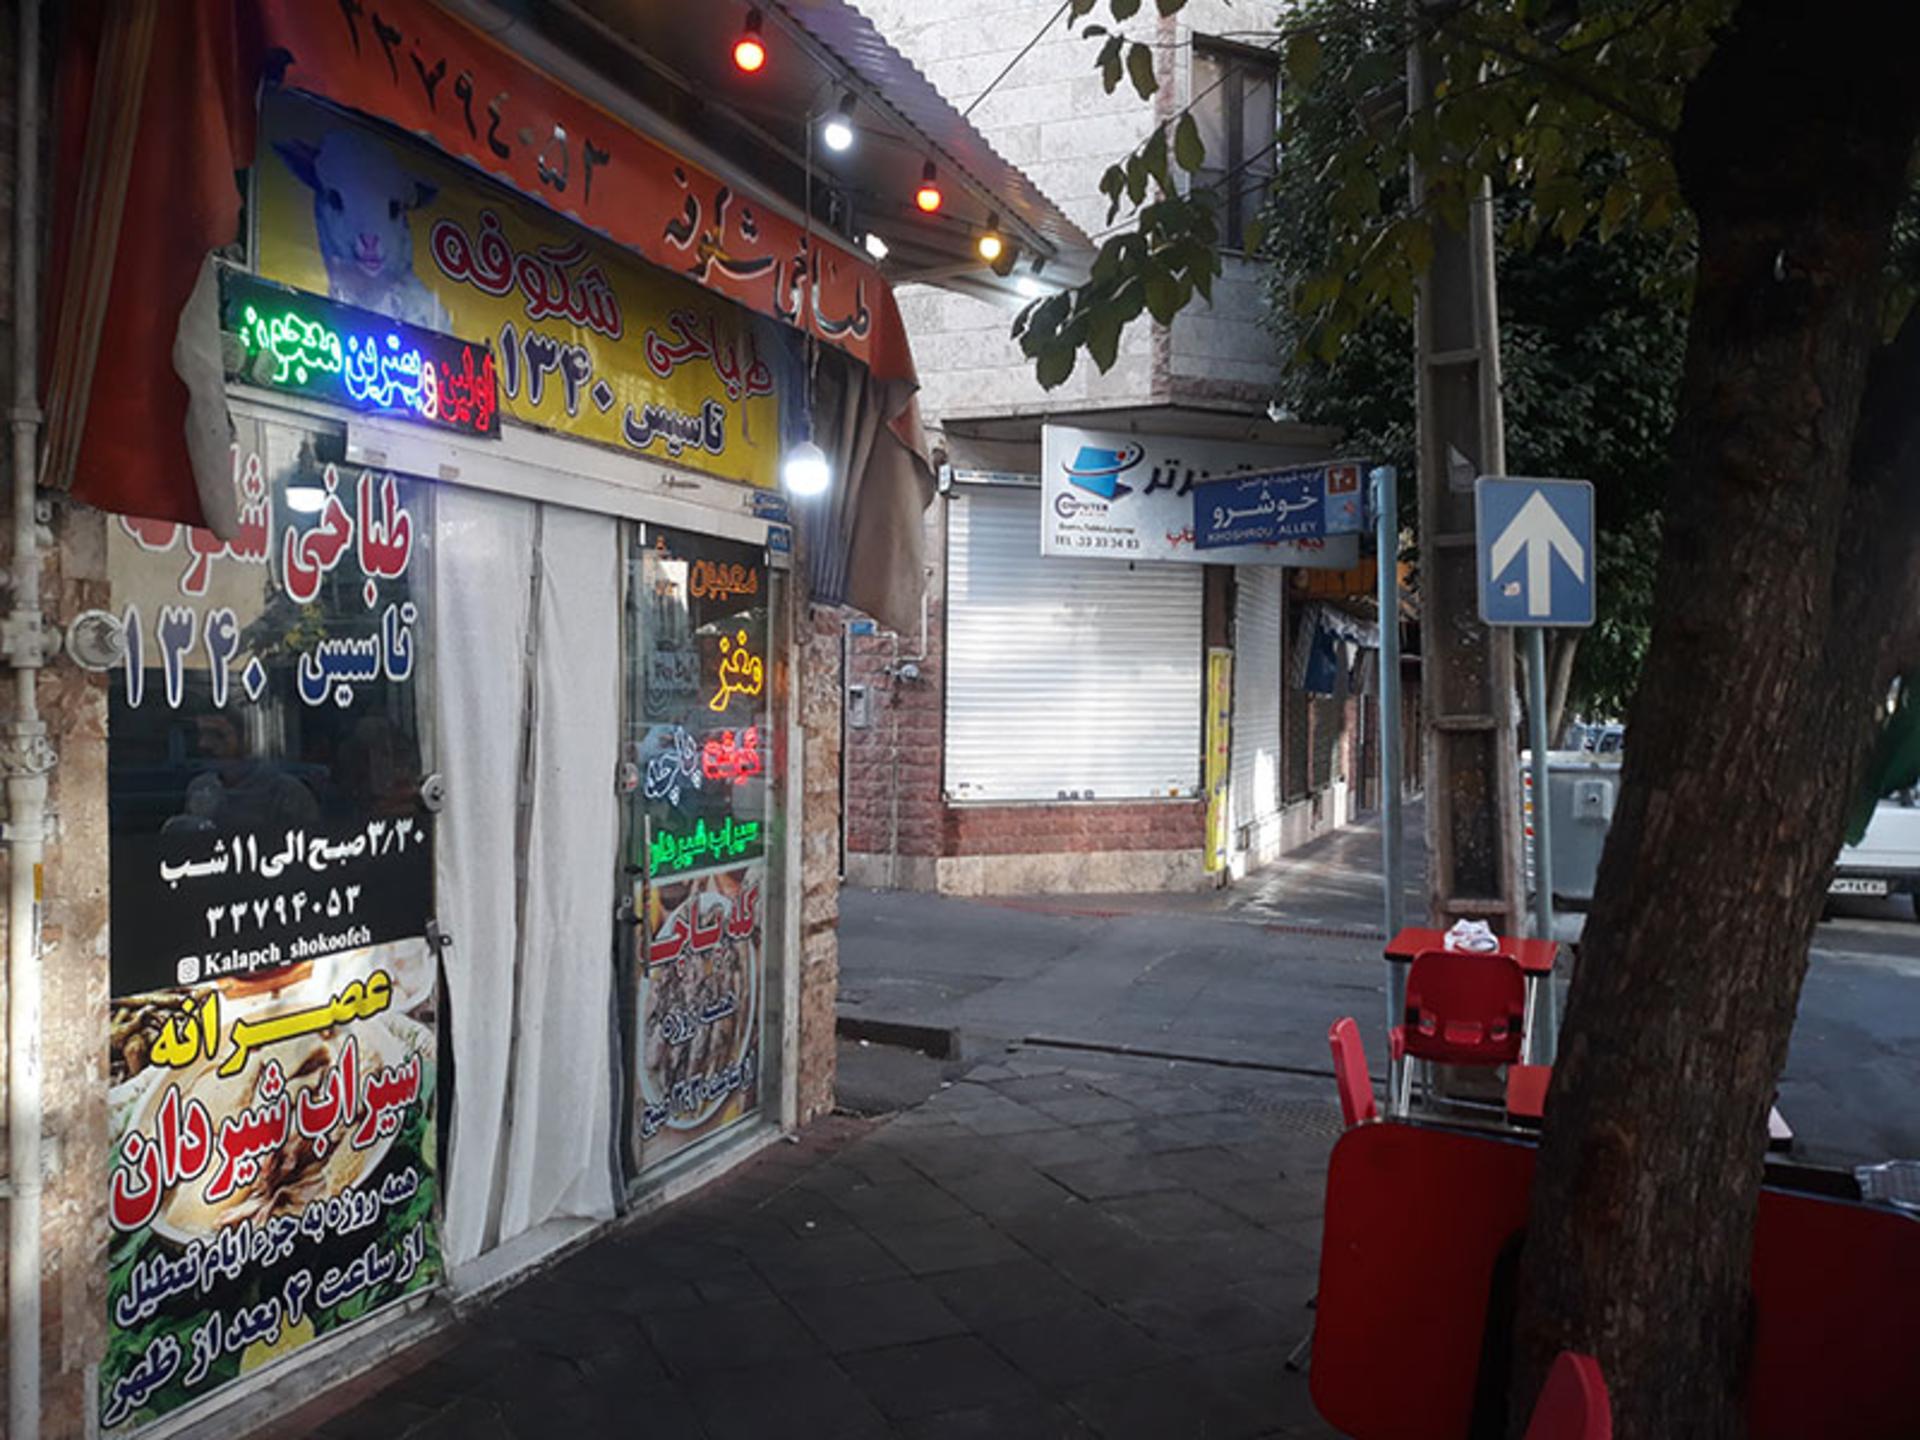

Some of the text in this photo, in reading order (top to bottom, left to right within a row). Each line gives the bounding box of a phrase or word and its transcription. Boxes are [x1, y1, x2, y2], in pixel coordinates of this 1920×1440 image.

[430, 210, 775, 400] طباخی شکوفه
[501, 324, 725, 456] تاسیس ۱۳۴۰
[284, 463, 412, 609] طباخی
[1212, 480, 1319, 530] خوشرو
[1277, 520, 1319, 536] ALLEY
[122, 602, 418, 708] تاسیس ۱۳۴۰
[709, 629, 764, 711] مغز
[159, 838, 230, 889] شب
[232, 834, 256, 875] ۱۱
[260, 830, 305, 877] الی
[307, 833, 367, 871] صبح
[149, 969, 393, 1077] عصرانه
[107, 1034, 423, 1231] سیراب شیردان
[326, 1187, 382, 1237] روزه
[380, 1166, 418, 1206] همه
[115, 1240, 201, 1328] تعطیل
[201, 1221, 251, 1293] ایام
[316, 1243, 398, 1310] ساعت
[396, 1222, 425, 1284] از
[183, 1313, 223, 1386] از
[224, 1296, 283, 1353] بعد
[102, 1333, 183, 1427] ظهر
